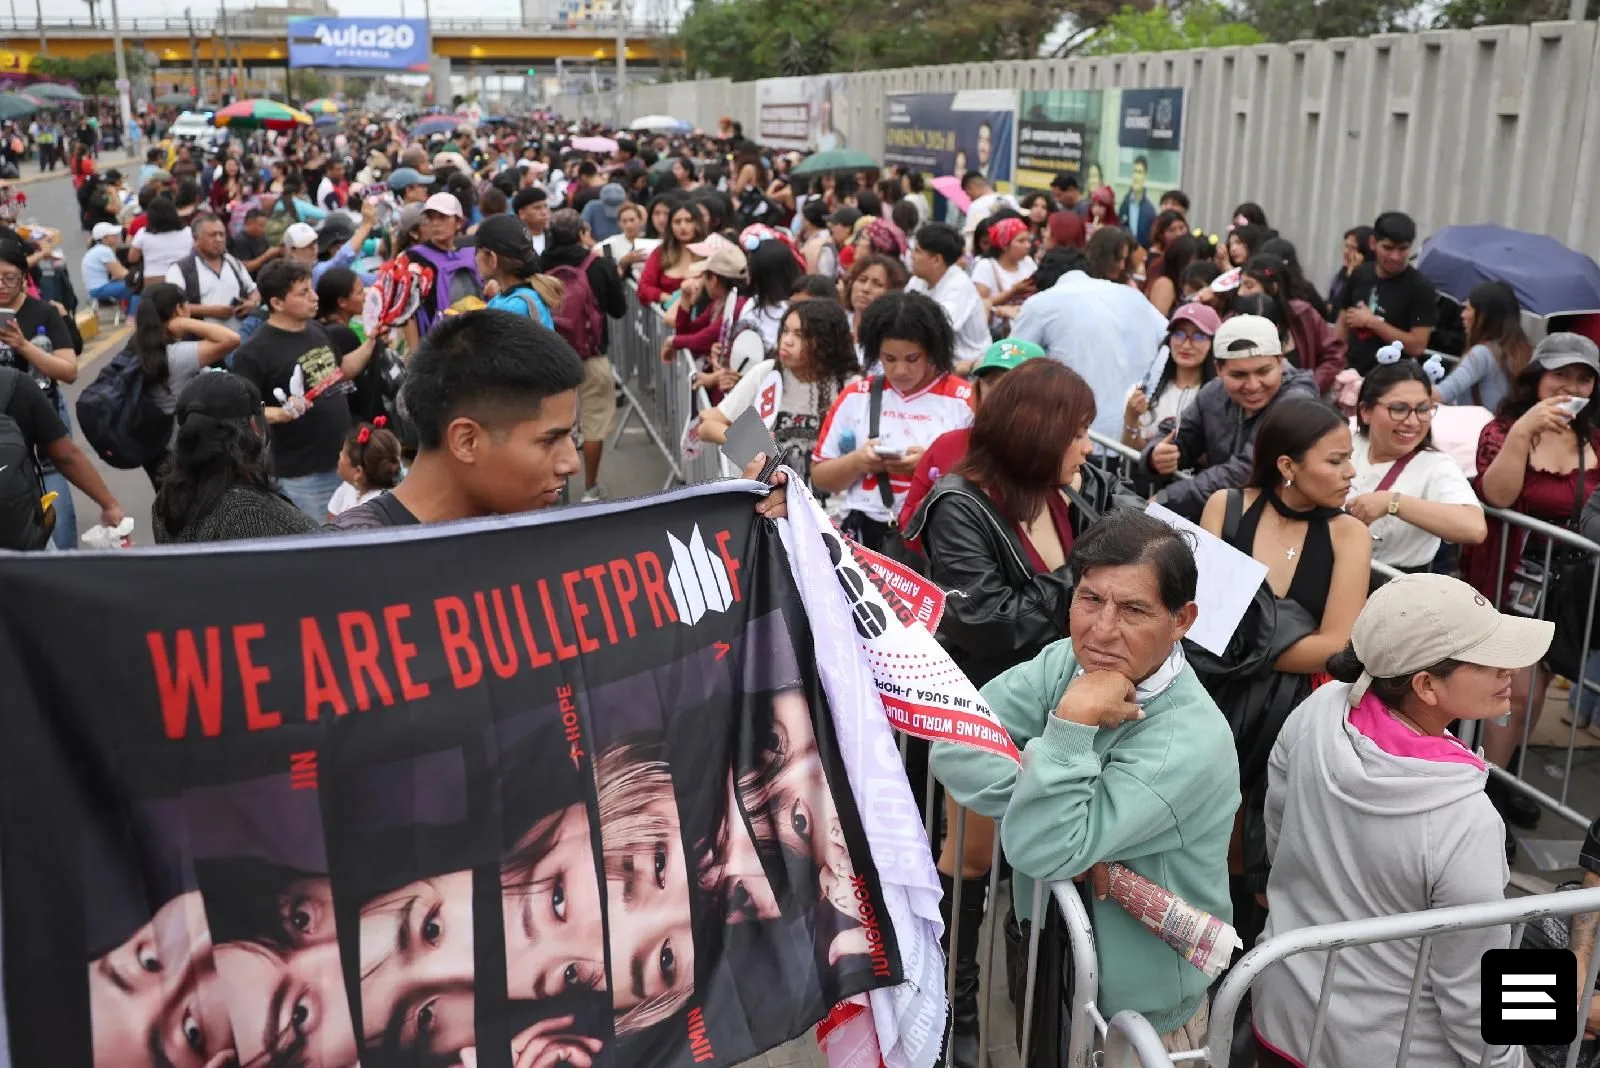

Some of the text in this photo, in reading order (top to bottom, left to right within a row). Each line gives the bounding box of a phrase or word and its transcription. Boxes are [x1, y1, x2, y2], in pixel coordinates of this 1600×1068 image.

[314, 23, 416, 48] Aula20
[711, 639, 732, 662] V
[146, 622, 283, 740] WE
[300, 602, 431, 722] ARE
[916, 688, 950, 705] SUGA
[953, 696, 972, 709] JIN
[885, 703, 910, 725] TOUR
[912, 712, 953, 734] WORLD
[289, 750, 319, 790] JIN
[848, 873, 891, 977] JUNGKOOK
[687, 1006, 715, 1063] JIMIN
